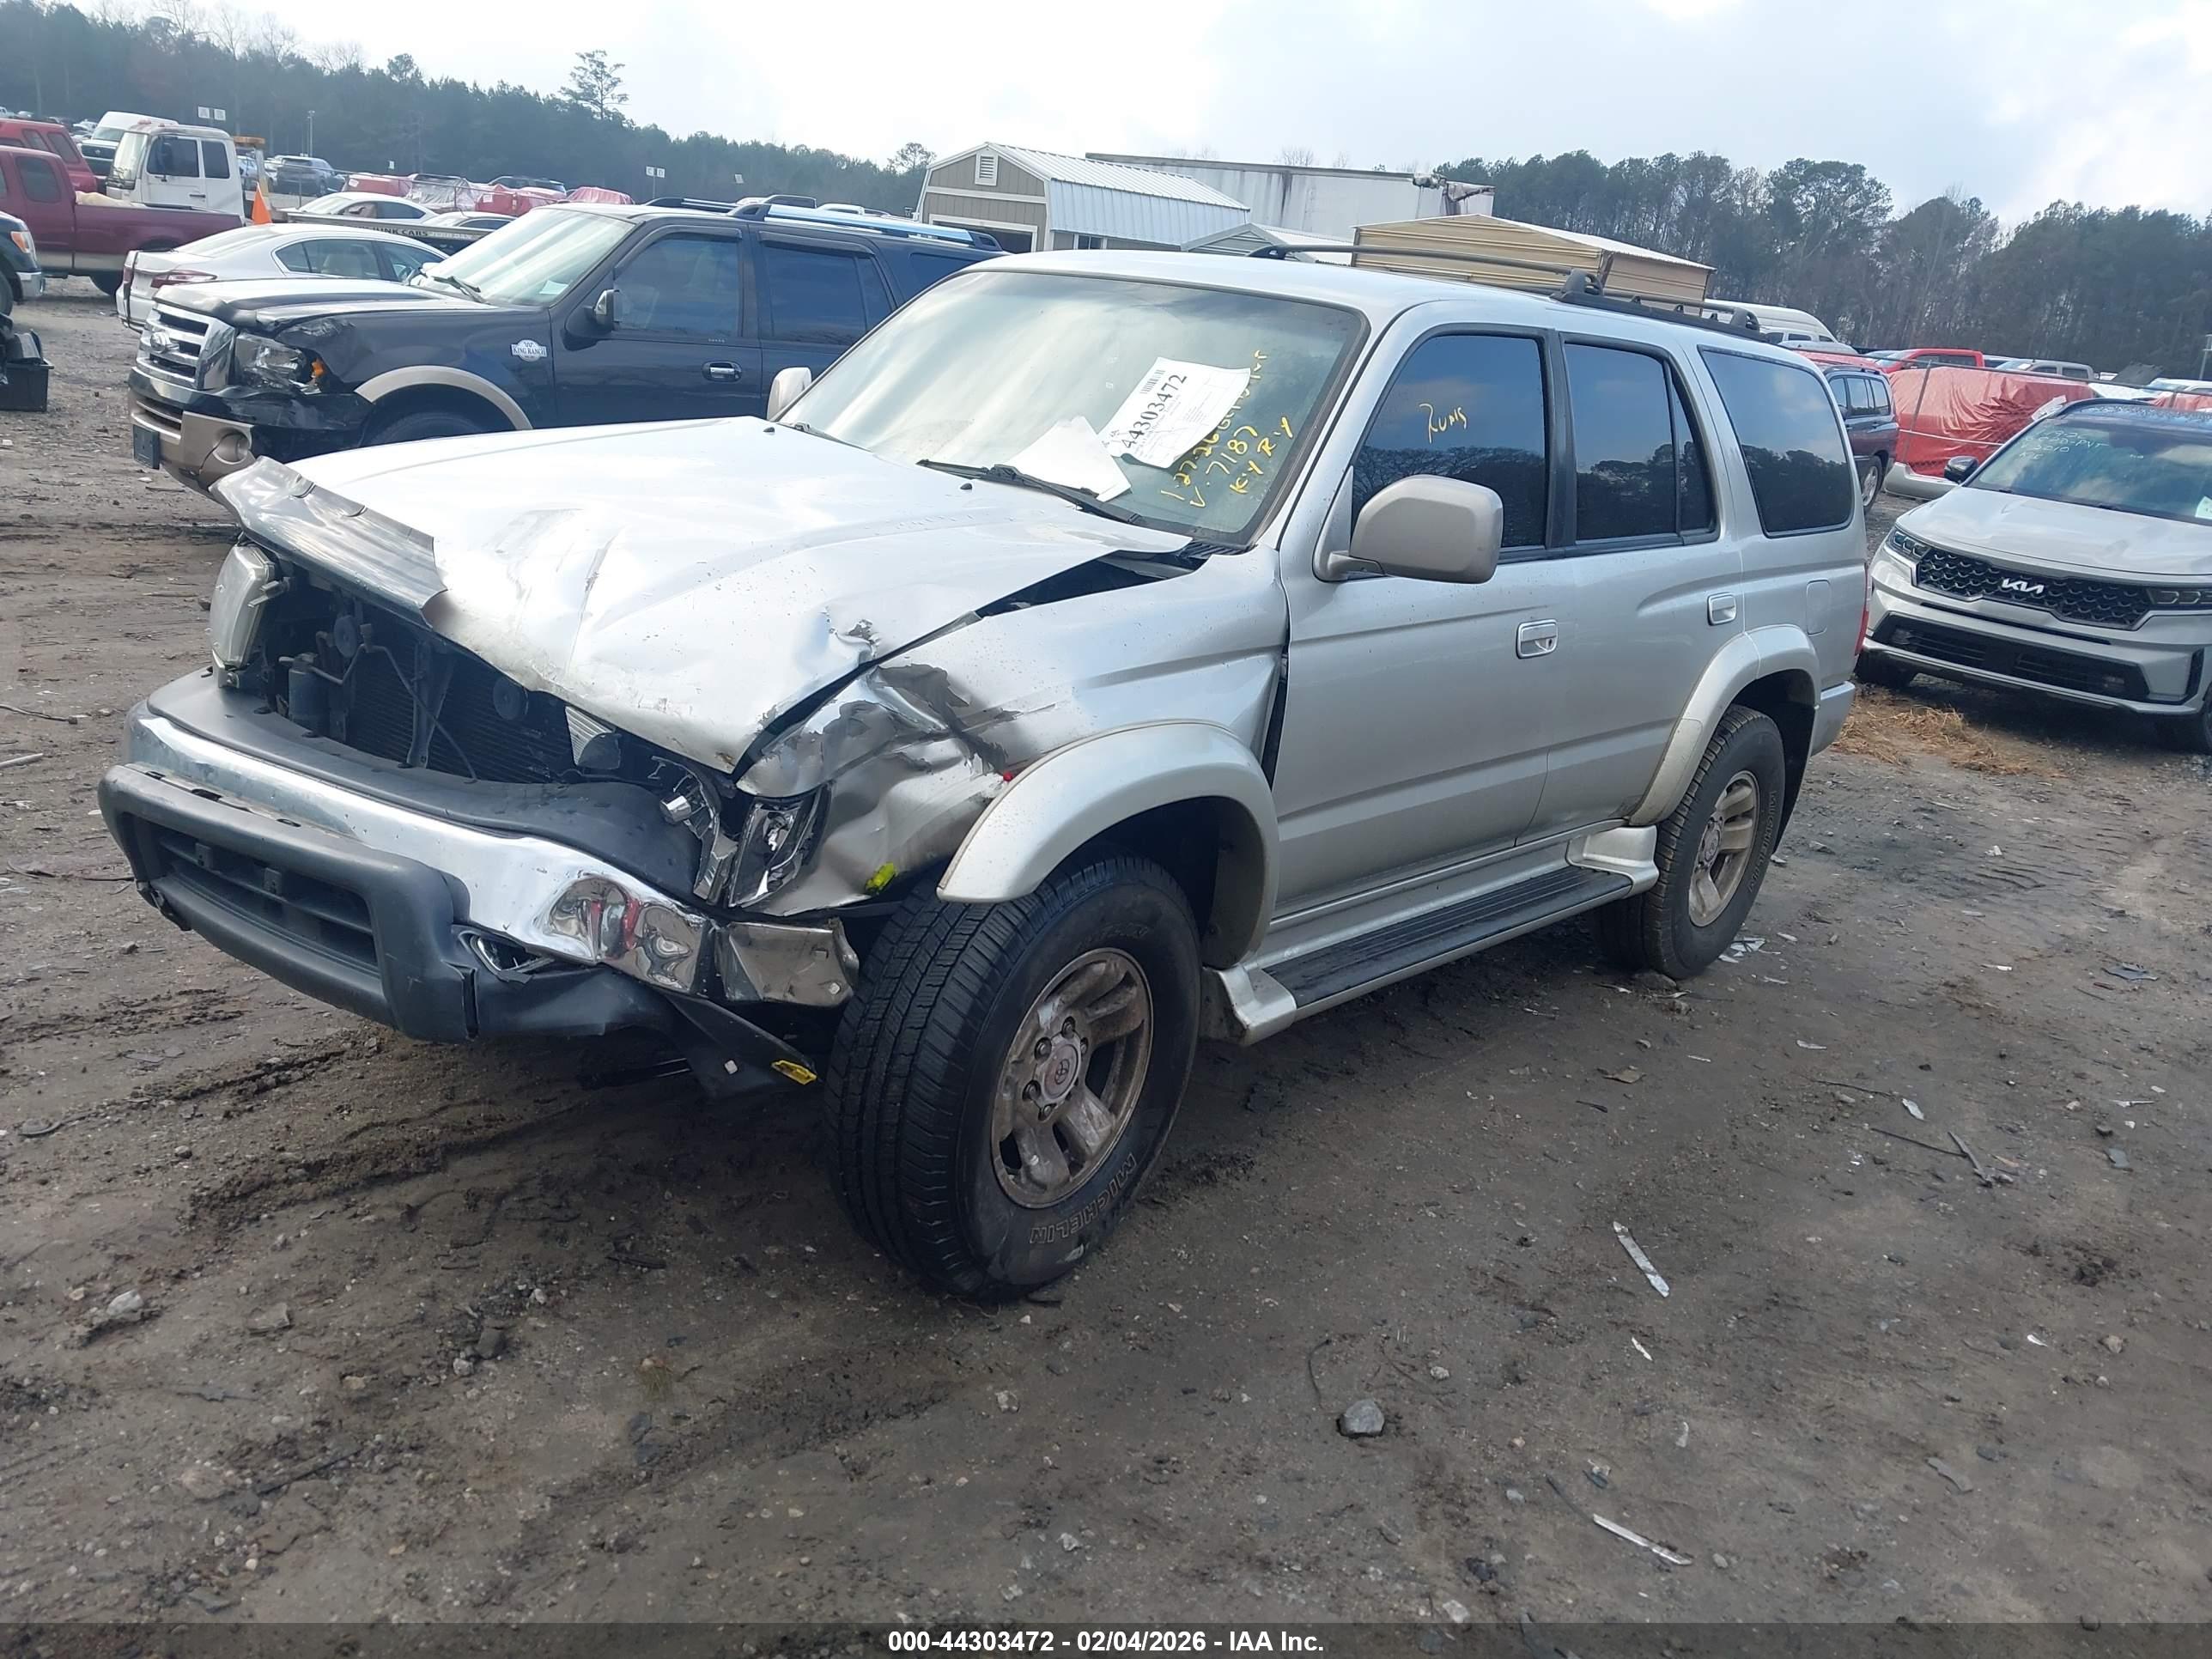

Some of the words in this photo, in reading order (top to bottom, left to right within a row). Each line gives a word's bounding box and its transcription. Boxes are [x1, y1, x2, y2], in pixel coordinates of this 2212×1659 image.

[527, 347, 546, 356] RANCH
[1121, 374, 1188, 449] 44303472
[1030, 1152, 1137, 1244] MICHELIN
